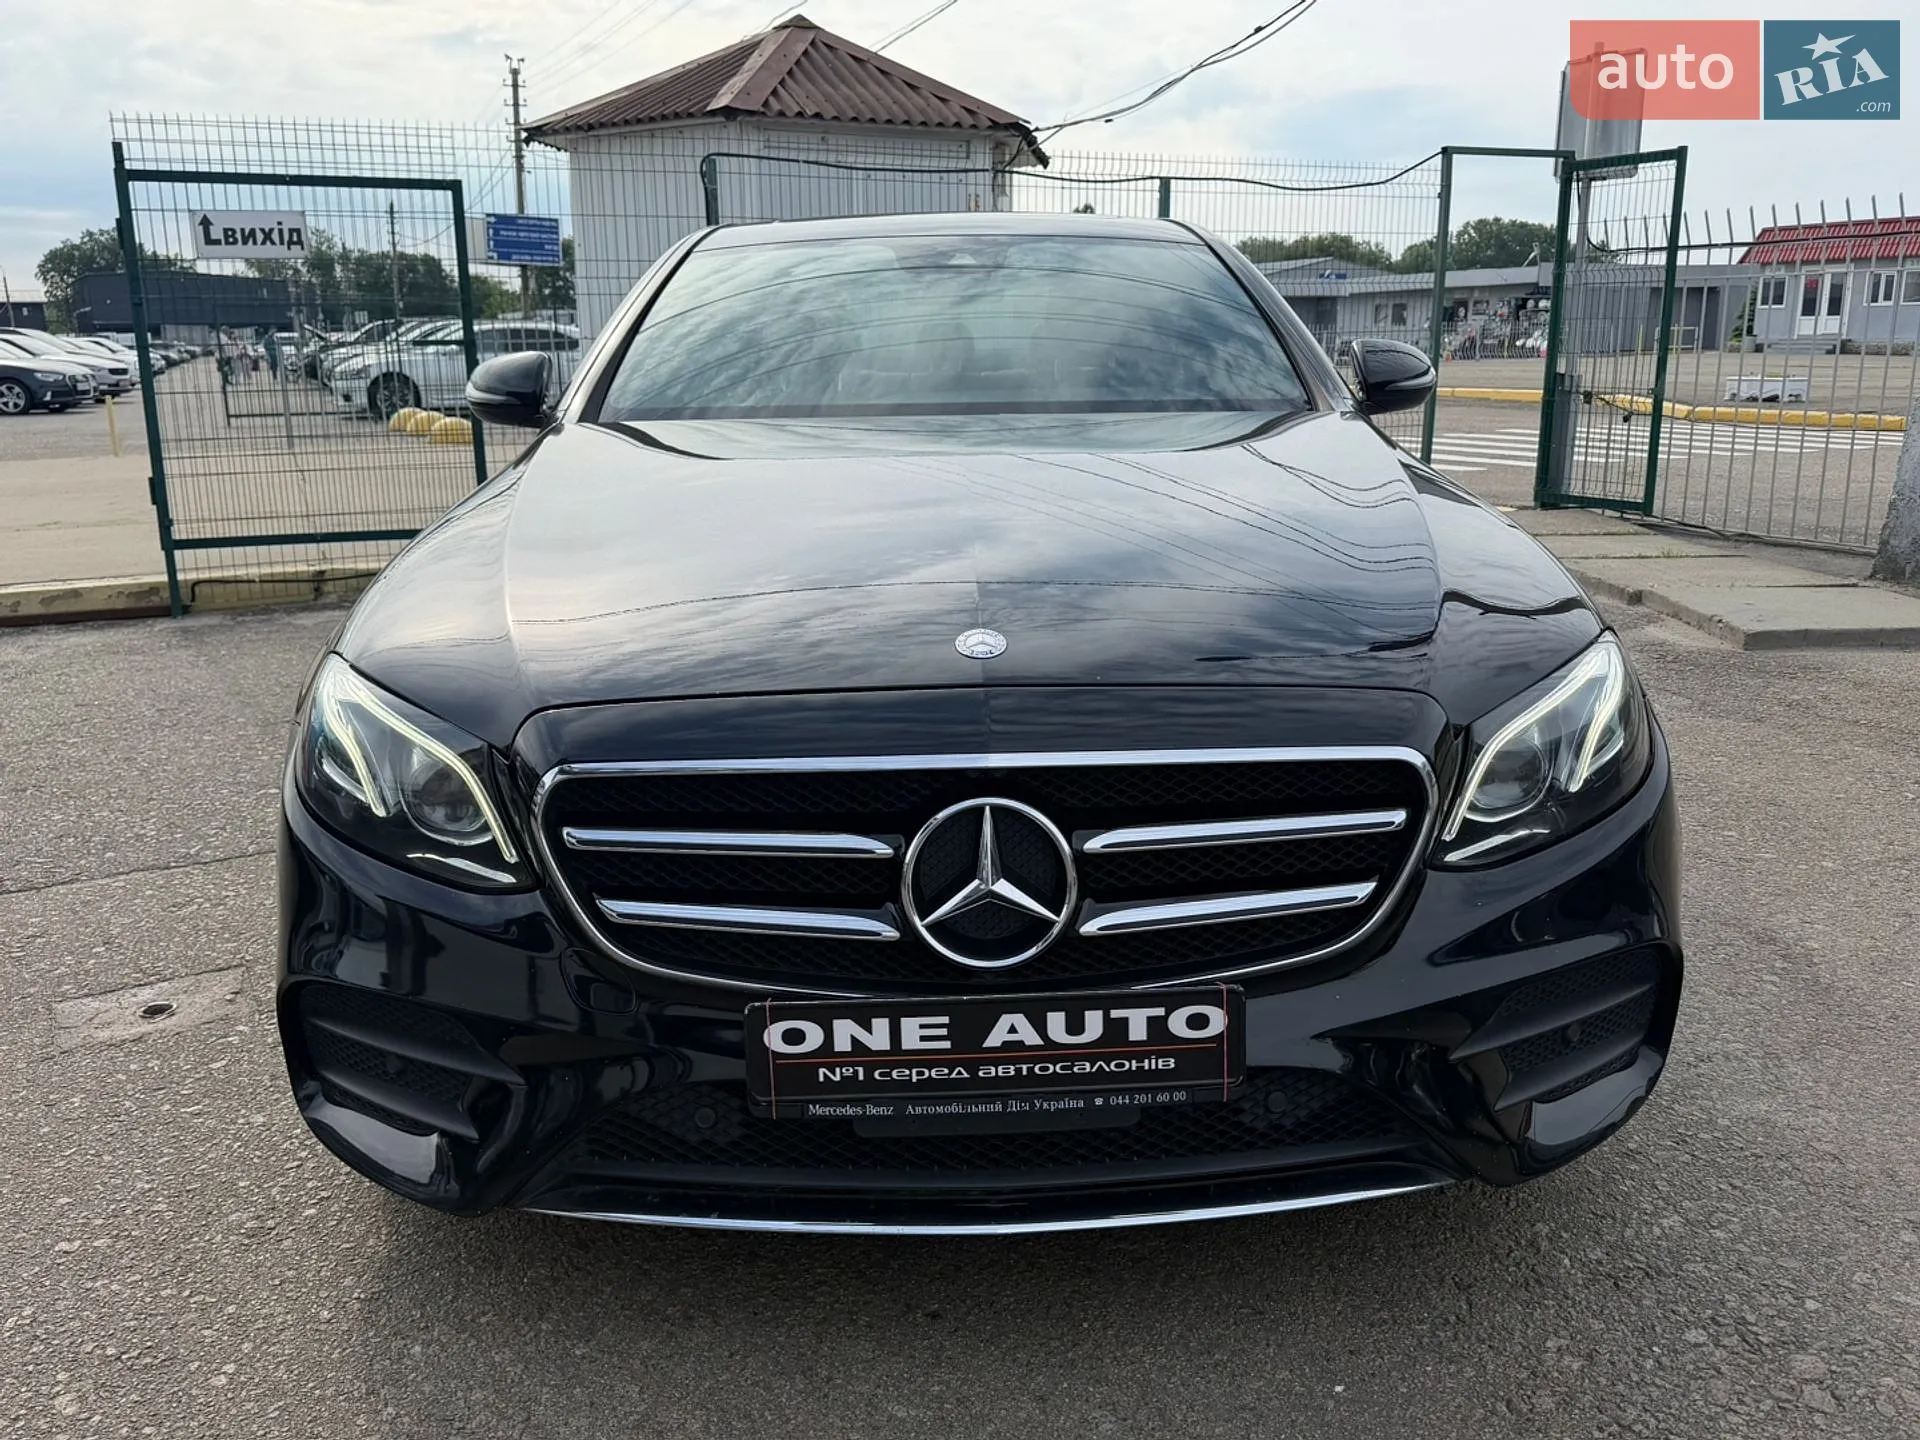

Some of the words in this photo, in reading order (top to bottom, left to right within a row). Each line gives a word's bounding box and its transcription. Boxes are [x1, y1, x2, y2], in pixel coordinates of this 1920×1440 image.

[222, 221, 304, 251] вихід
[763, 1016, 951, 1054] ONE
[982, 1005, 1228, 1048] AUTO
[874, 1065, 970, 1082] серед
[978, 1056, 1176, 1077] автосалонів
[808, 1104, 894, 1116] Mercedes-Benz
[906, 1100, 1002, 1115] Автомобільний
[1034, 1098, 1085, 1110] Україна
[1109, 1094, 1129, 1105] 044
[1134, 1094, 1152, 1104] 201
[1156, 1092, 1170, 1103] 60
[1173, 1091, 1187, 1101] 00
